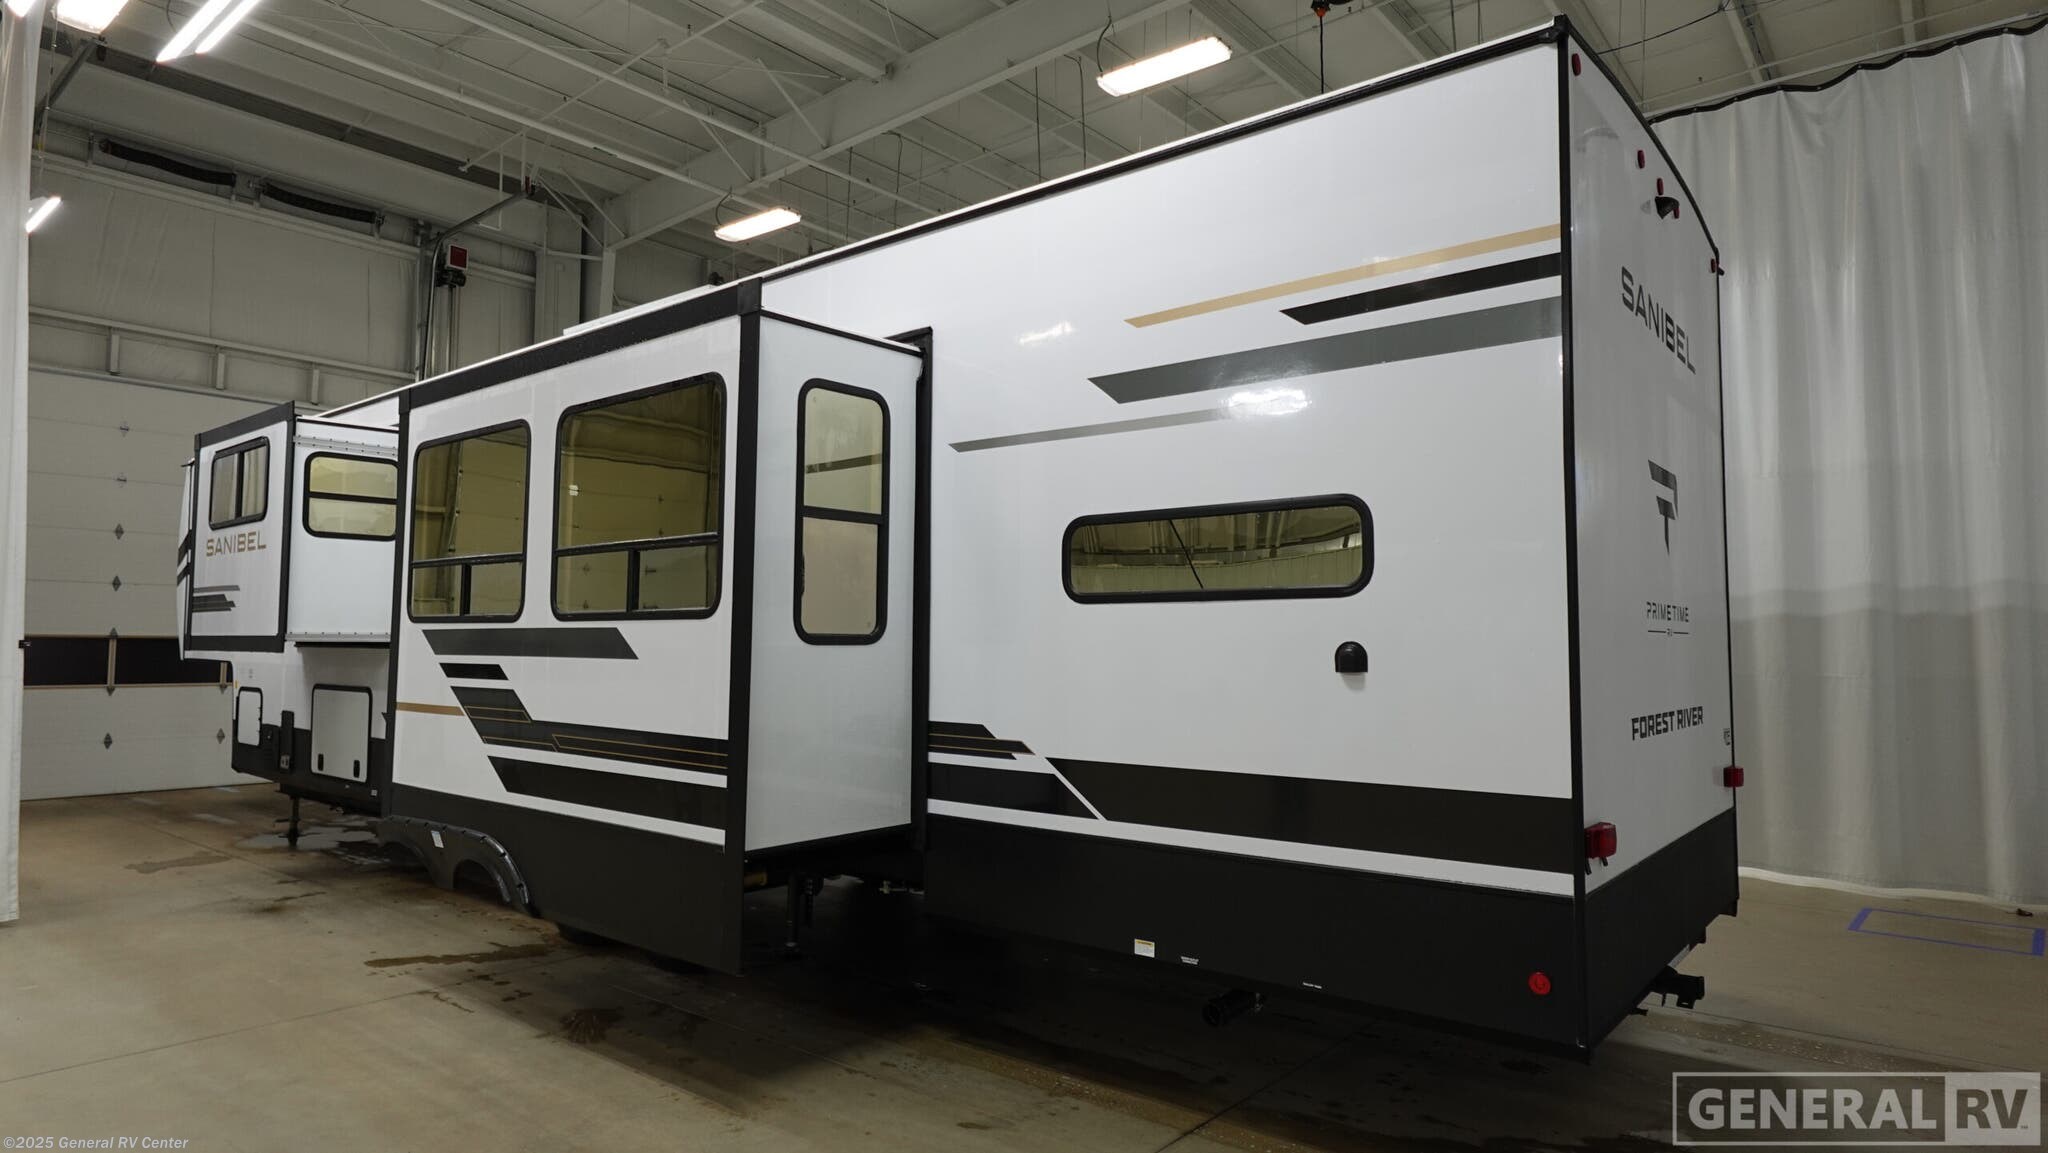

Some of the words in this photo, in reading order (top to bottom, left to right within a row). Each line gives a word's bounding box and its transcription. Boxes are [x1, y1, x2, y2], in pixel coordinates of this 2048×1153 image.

[1621, 266, 1696, 375] SANIBEL
[206, 531, 267, 557] SANIBEL
[1631, 710, 1675, 741] FOREST
[1676, 706, 1704, 731] RIVER
